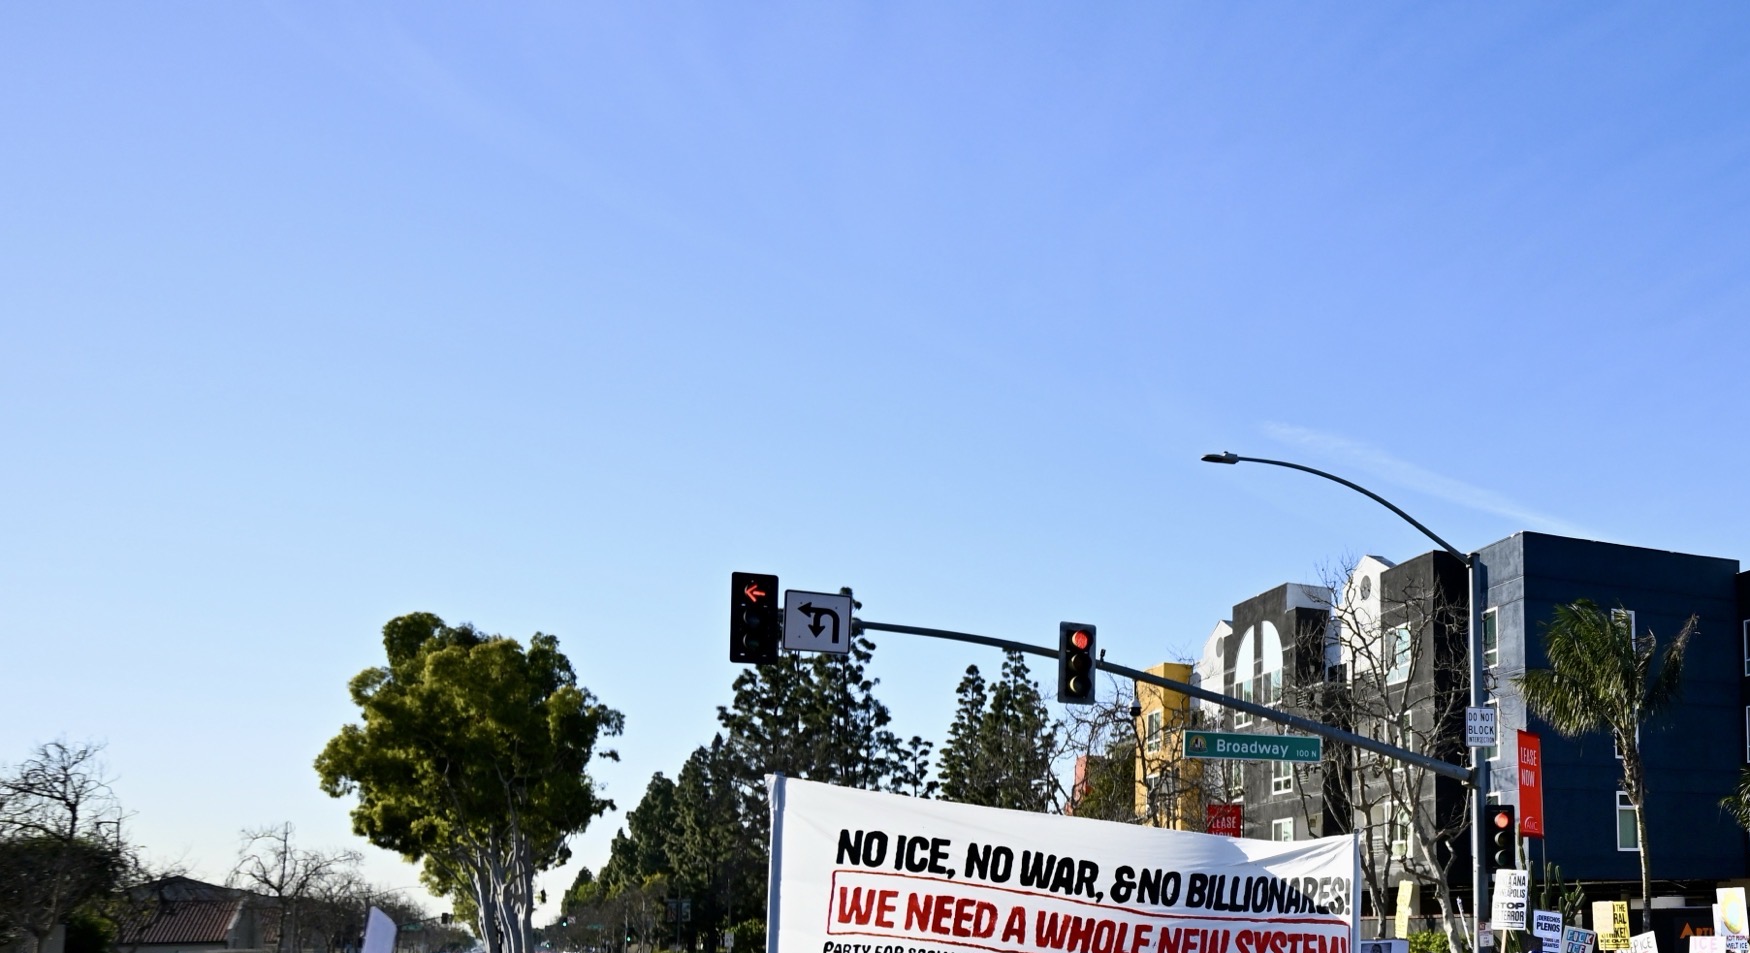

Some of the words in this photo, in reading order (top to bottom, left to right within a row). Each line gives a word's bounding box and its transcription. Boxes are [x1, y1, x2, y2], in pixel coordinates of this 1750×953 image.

[1468, 713, 1478, 722] DO
[1480, 713, 1494, 722] NOT
[1468, 726, 1494, 735] BLOCK
[1217, 738, 1289, 758] Broadway
[1312, 750, 1317, 758] N
[1520, 746, 1537, 766] LEASE
[1521, 769, 1535, 788] NOW
[1212, 816, 1236, 829] LEASE
[836, 829, 888, 868] NO
[894, 834, 956, 879] ICE,
[964, 842, 1014, 884] NO
[1019, 850, 1104, 903] WAR,
[1185, 872, 1351, 915] BILLIONARES!
[837, 886, 899, 929] WE
[904, 892, 998, 938] NEED
[1001, 906, 1026, 945] A
[1536, 923, 1560, 933] PLENOS
[1567, 929, 1594, 945] FUCK
